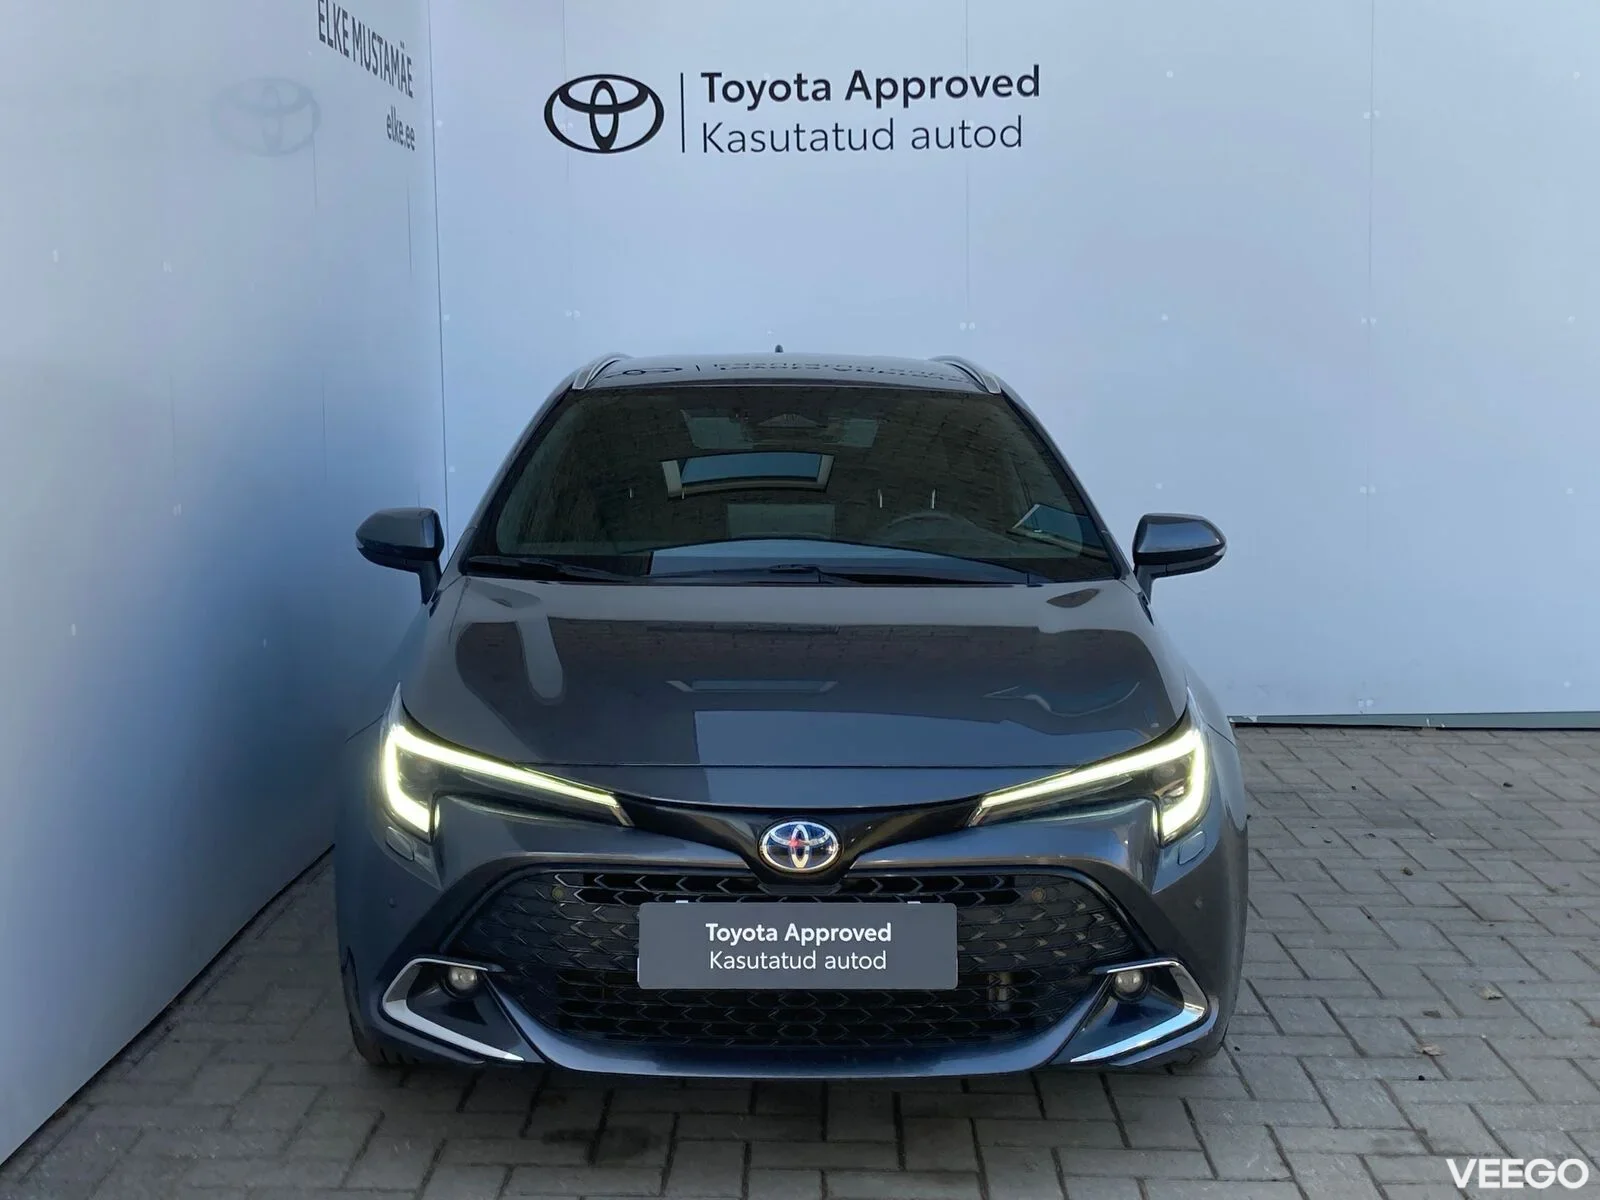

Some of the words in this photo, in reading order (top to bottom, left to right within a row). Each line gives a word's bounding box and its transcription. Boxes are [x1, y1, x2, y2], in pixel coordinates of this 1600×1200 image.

[317, 0, 350, 58] ELKE
[352, 16, 414, 99] MUSTAMÄE
[701, 71, 831, 111] Toyota
[845, 64, 1040, 110] Approved
[386, 105, 415, 151] elke.ee
[702, 117, 894, 154] Kasutatud
[910, 114, 1023, 151] autod
[705, 922, 778, 946] Toyota
[784, 922, 892, 946] Approved
[709, 950, 817, 970] Kasutatud
[824, 950, 887, 970] autod
